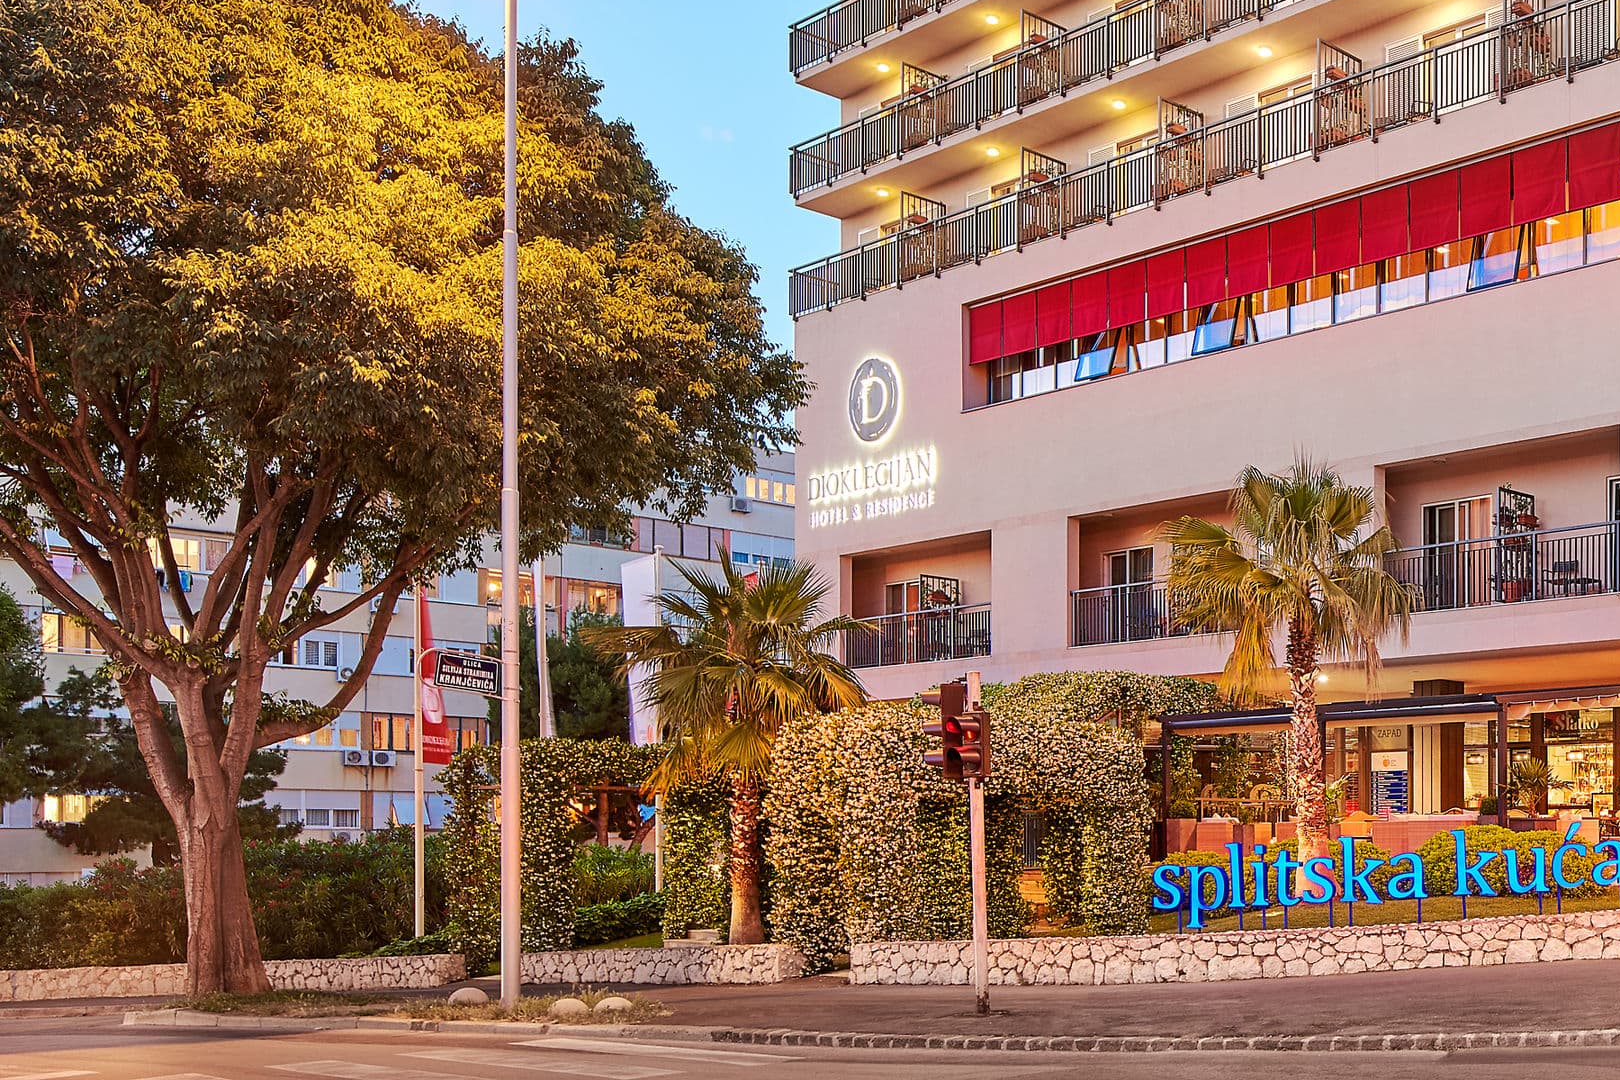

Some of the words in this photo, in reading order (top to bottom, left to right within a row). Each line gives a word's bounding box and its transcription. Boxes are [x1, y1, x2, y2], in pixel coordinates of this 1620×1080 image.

[807, 451, 934, 502] DIOKLECIJAN
[810, 507, 848, 528] HOTEL
[851, 504, 862, 521] &
[865, 489, 934, 519] RESIDENCE
[463, 659, 482, 668] ULICA
[439, 673, 494, 690] KRANJČEVIĆA
[1377, 728, 1402, 738] ZAPAD
[1153, 837, 1428, 928] splitska
